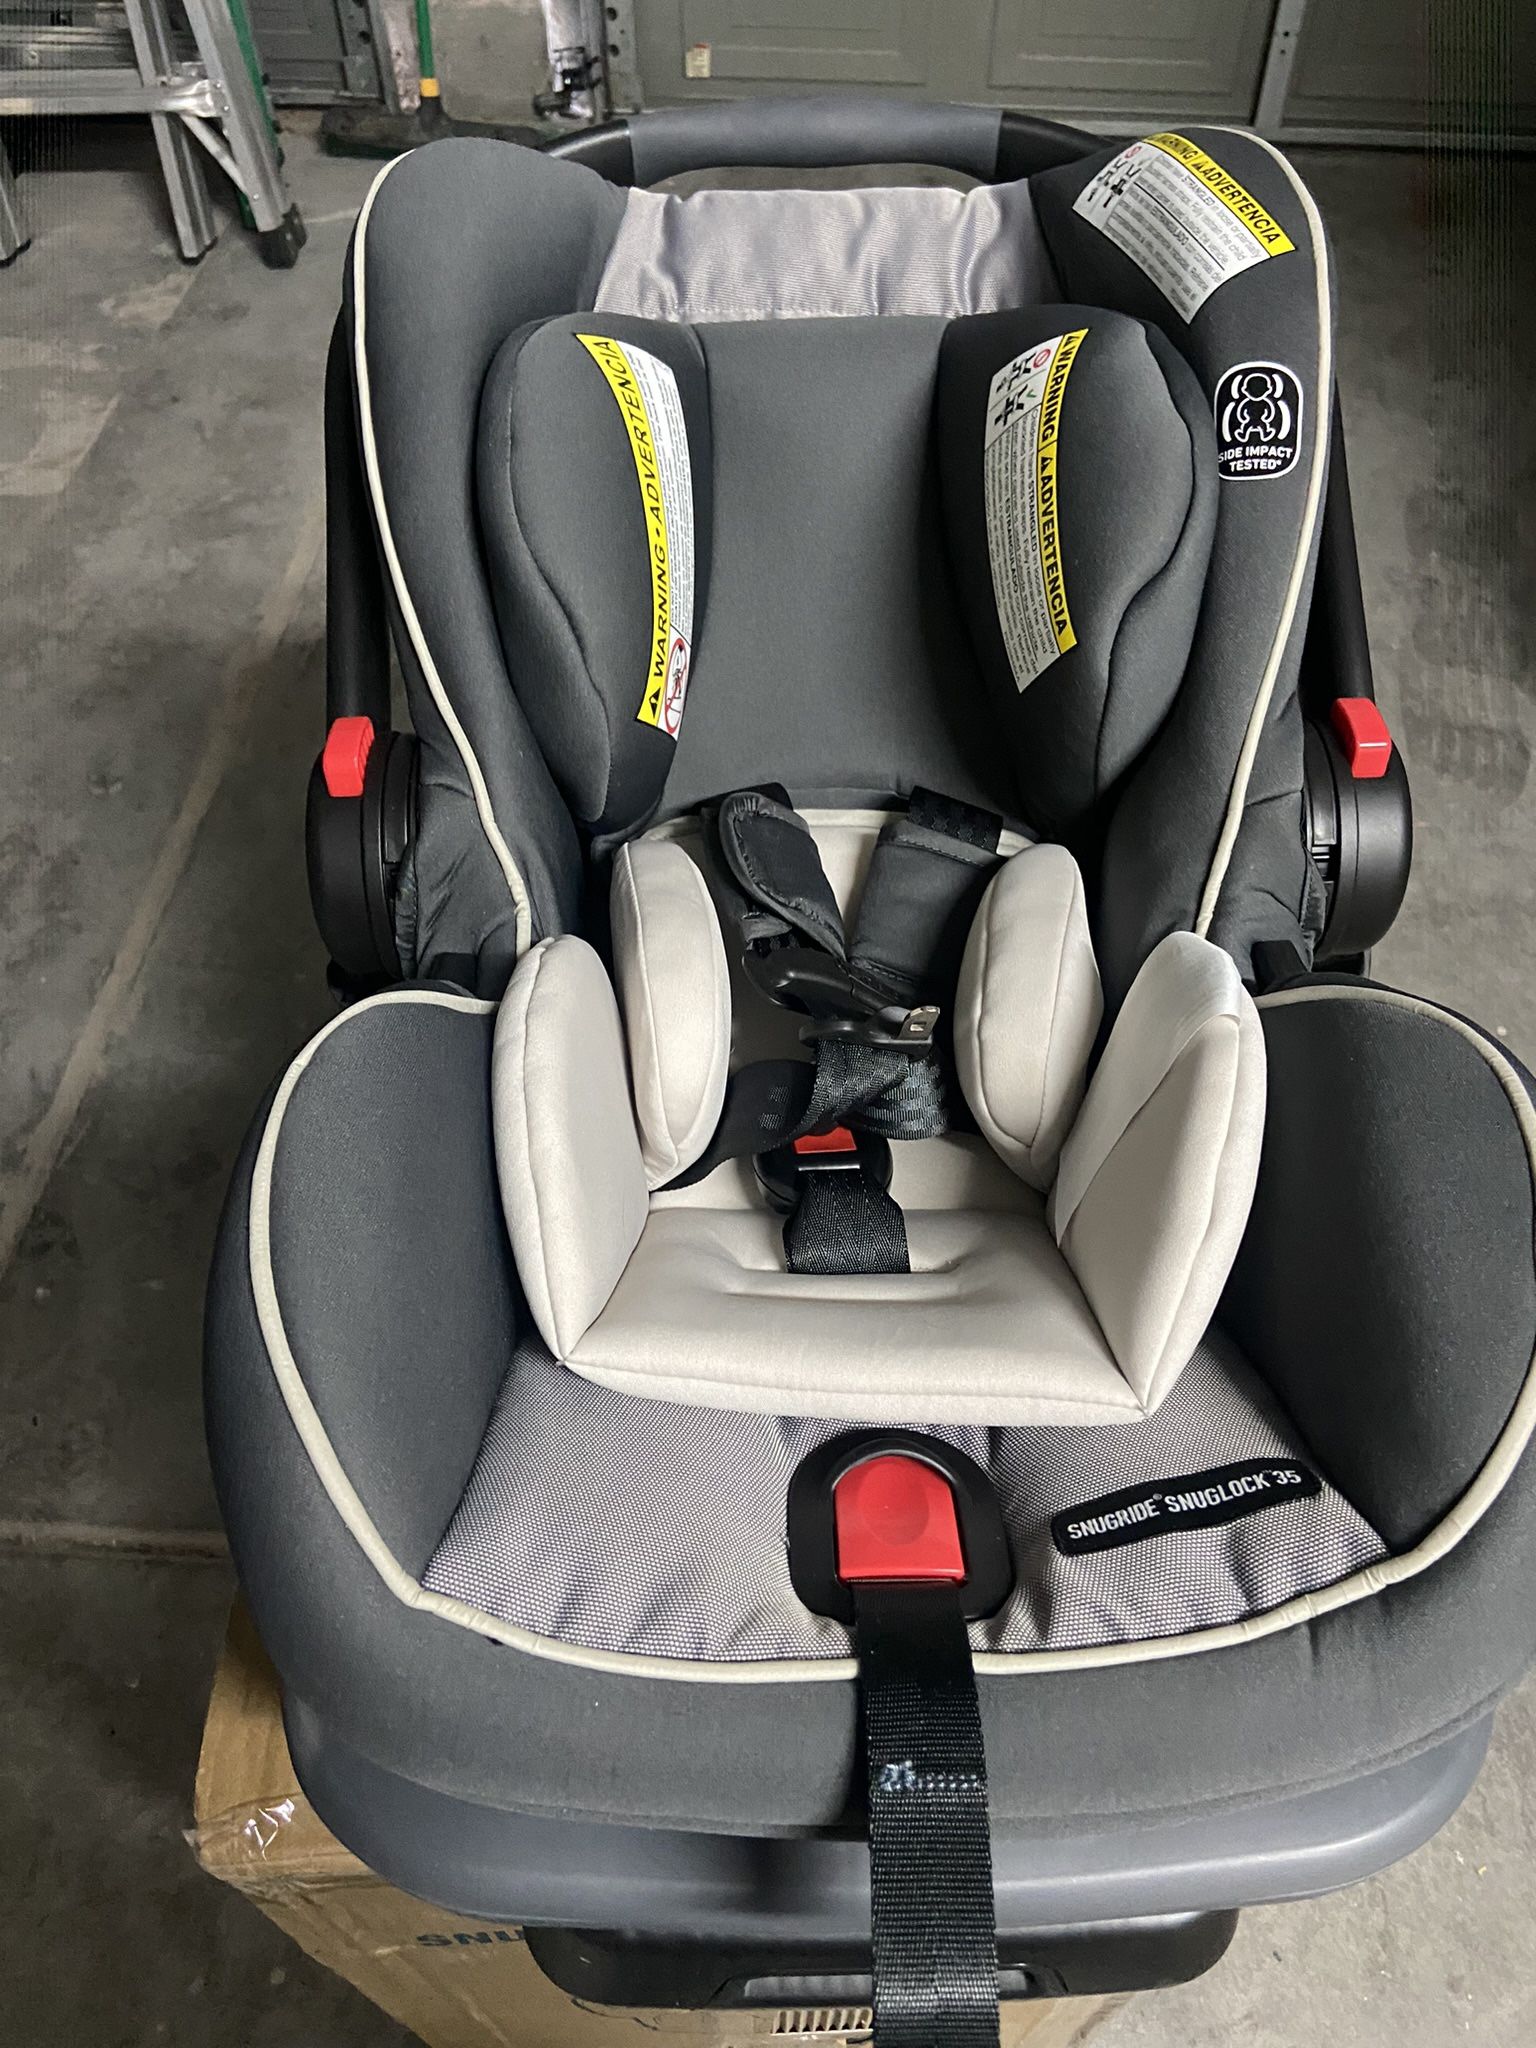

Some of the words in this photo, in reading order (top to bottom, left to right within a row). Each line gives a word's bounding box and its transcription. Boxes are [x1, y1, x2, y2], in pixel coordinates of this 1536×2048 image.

[1200, 165, 1282, 246] ADVERTENCIA
[594, 341, 663, 525] ADVERTENCIA
[1042, 347, 1075, 443] WARNING
[1218, 446, 1243, 462] SIDE
[1245, 445, 1293, 459] IMPACT
[1029, 479, 1038, 552] STRANGLED
[1040, 474, 1068, 636] ADVERTENCIA
[653, 546, 668, 677] WARNING
[1273, 1470, 1302, 1485] 35
